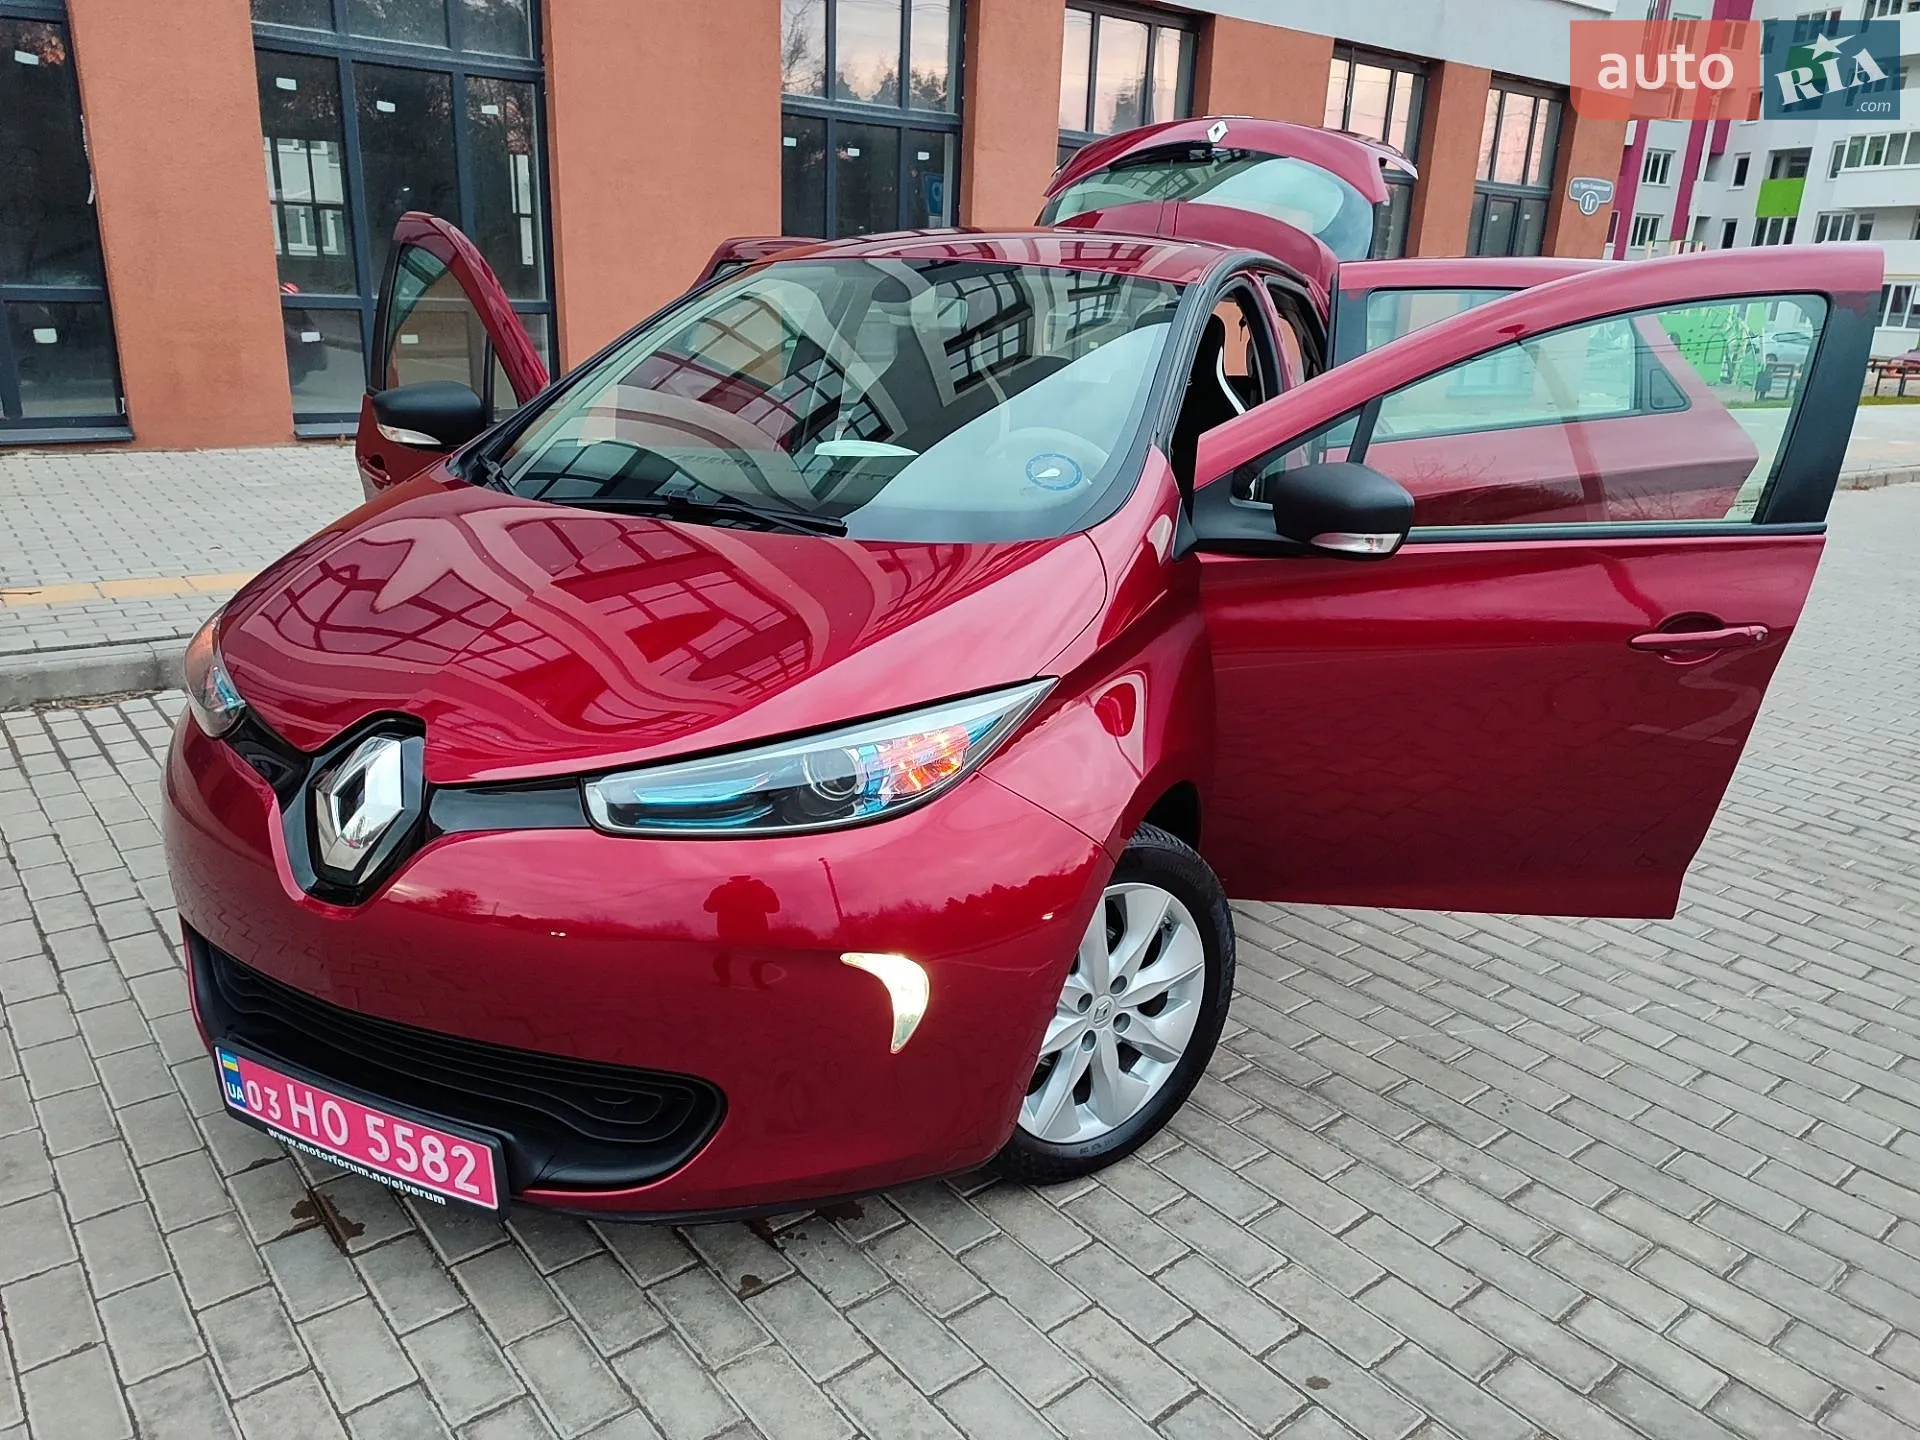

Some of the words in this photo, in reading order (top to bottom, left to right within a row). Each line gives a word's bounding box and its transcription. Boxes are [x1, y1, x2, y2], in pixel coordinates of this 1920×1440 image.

[227, 1081, 246, 1103] UA
[246, 1080, 282, 1121] 03
[286, 1083, 349, 1146] HO
[365, 1113, 481, 1195] 5582
[267, 1127, 446, 1206] www.motorforum.no/elverum
